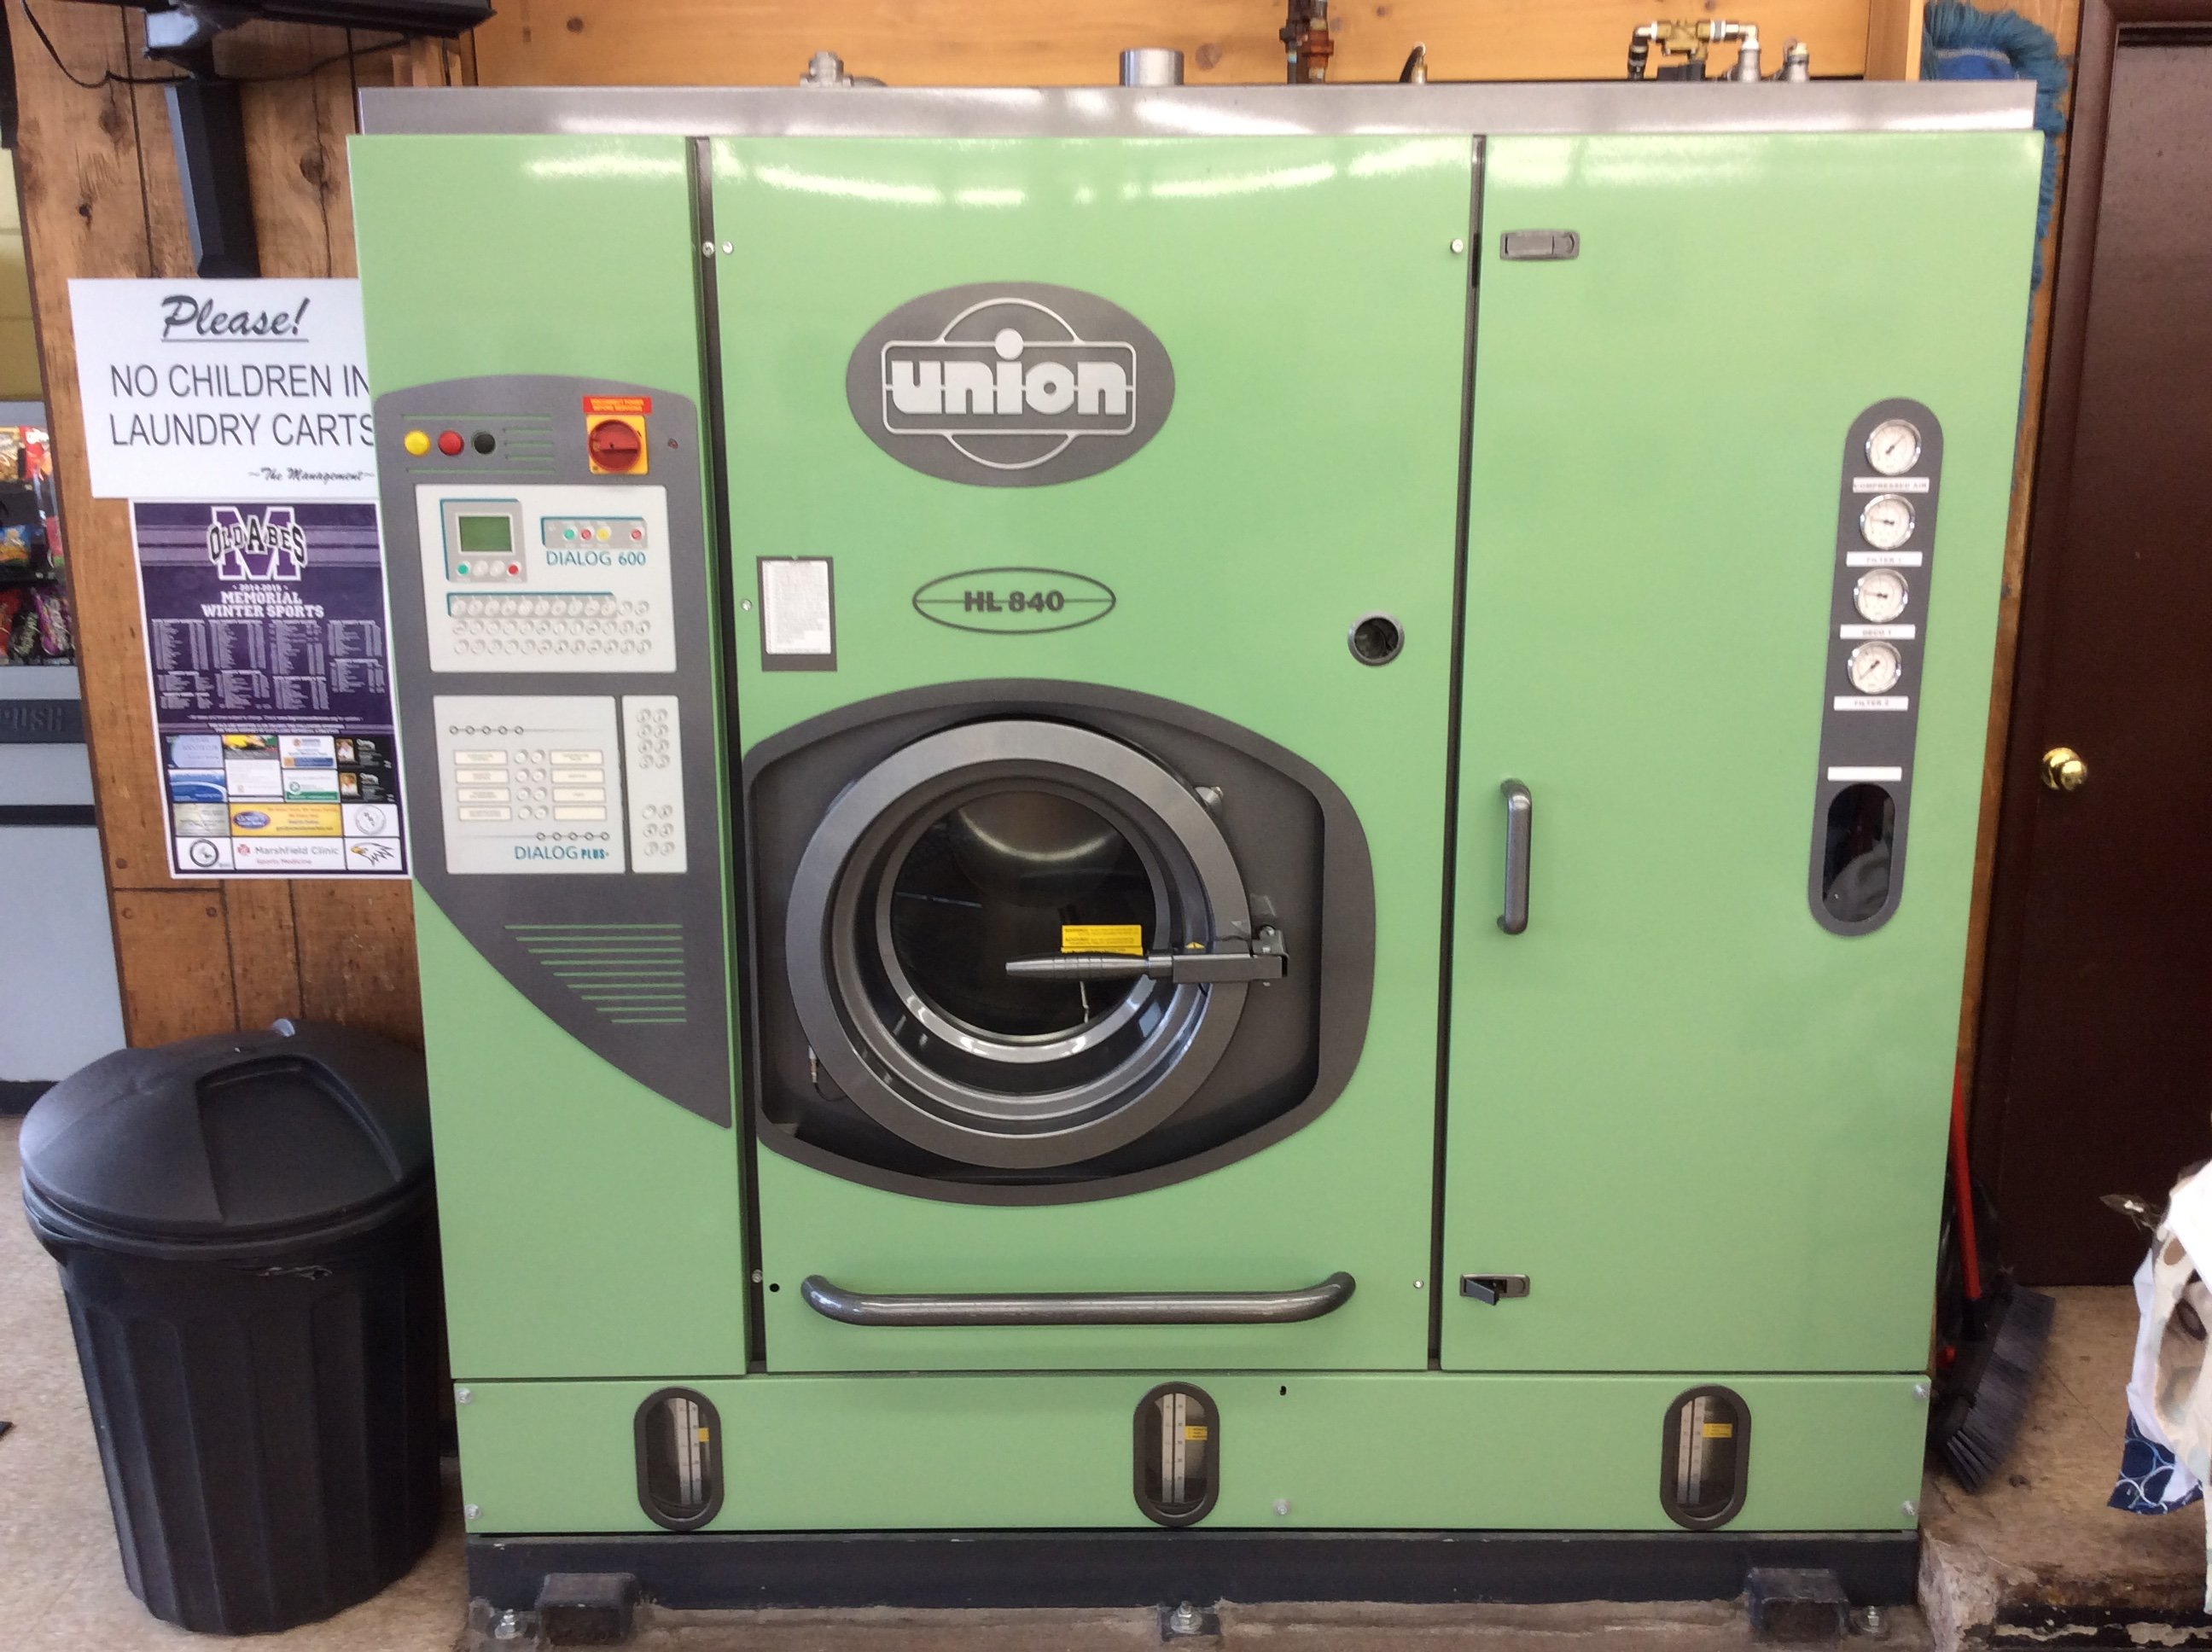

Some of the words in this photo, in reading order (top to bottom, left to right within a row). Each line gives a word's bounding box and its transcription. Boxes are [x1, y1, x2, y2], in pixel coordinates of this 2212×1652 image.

[160, 294, 311, 338] Please!
[110, 364, 158, 398] NO
[168, 364, 333, 398] CHILDREN
[343, 364, 370, 398] IN
[891, 328, 1127, 416] union
[109, 412, 260, 447] LAUNDRY
[271, 412, 374, 447] CARTS
[546, 550, 613, 567] DIALOG
[618, 550, 647, 567] 600
[220, 590, 303, 605] MEMORIAL
[963, 590, 1003, 613] HL
[1008, 590, 1066, 613] 840
[201, 603, 265, 619] WINTER
[265, 603, 325, 619] SPORTS
[255, 846, 309, 855] Marshfield
[311, 846, 341, 855] Clinic
[514, 846, 579, 860] DIALOG
